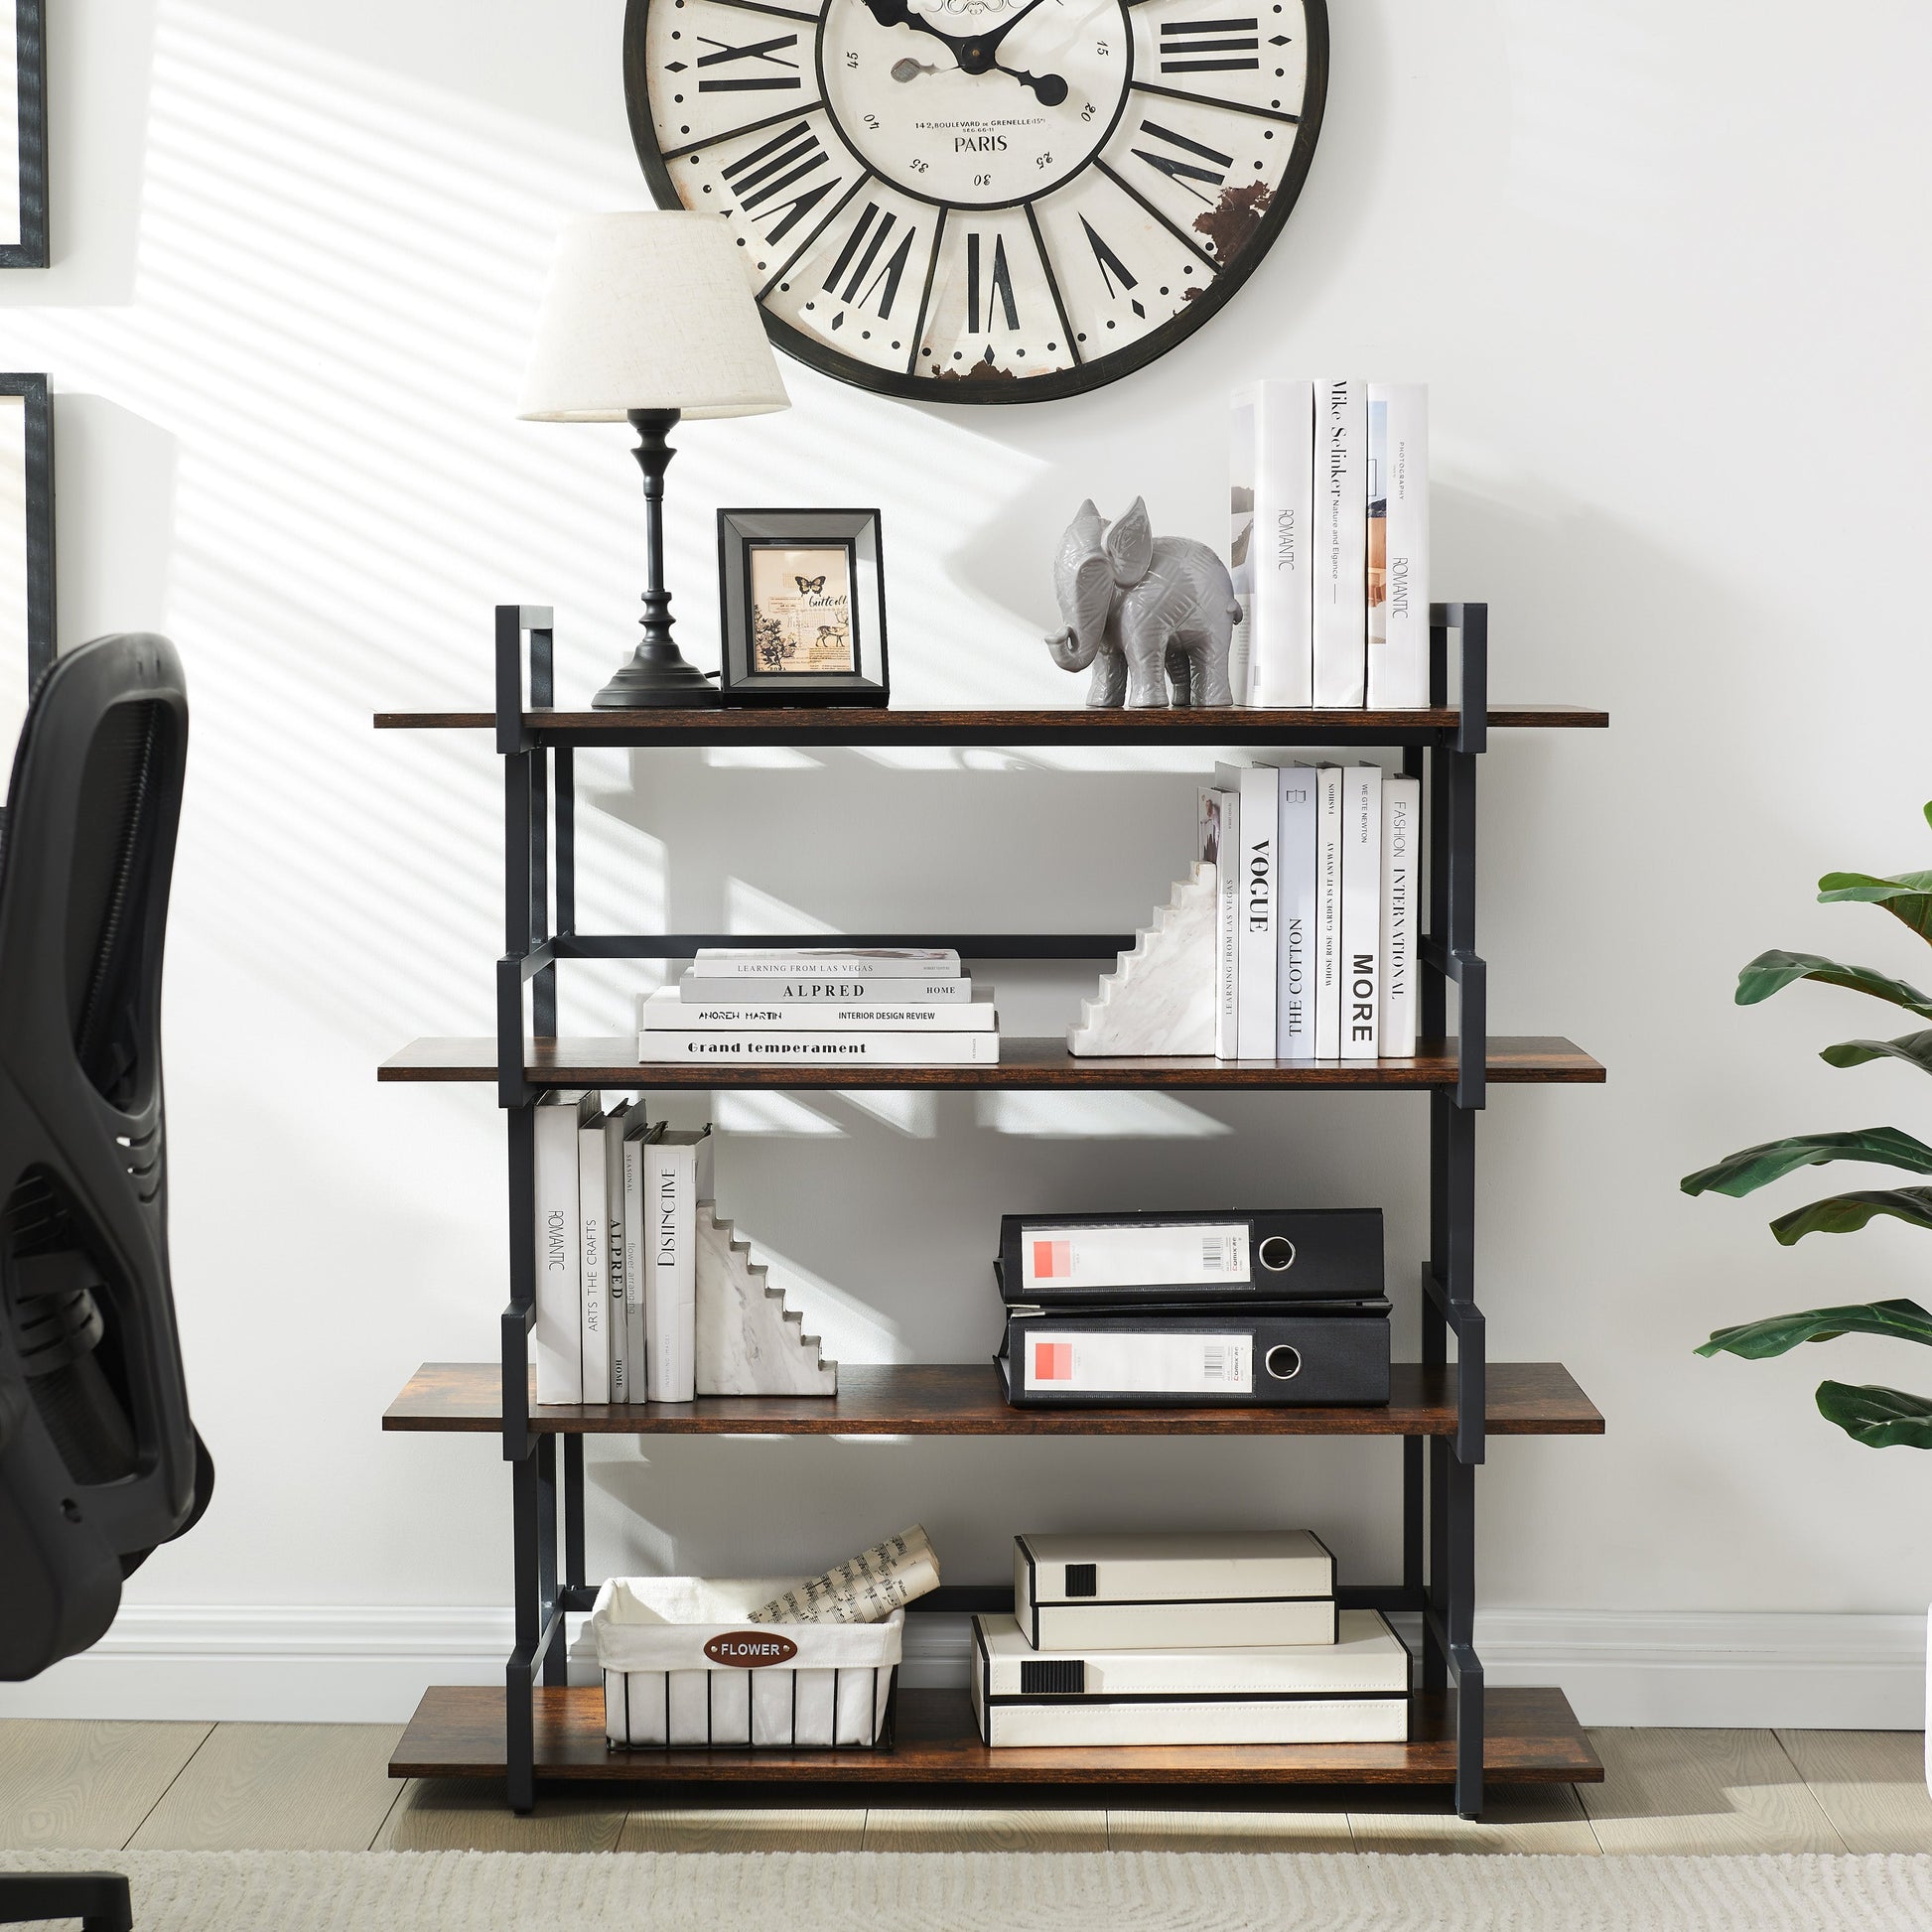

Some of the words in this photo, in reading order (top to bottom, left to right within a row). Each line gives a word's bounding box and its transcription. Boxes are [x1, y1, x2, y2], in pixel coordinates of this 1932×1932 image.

[847, 52, 859, 69] 45
[1097, 41, 1108, 56] 15
[864, 114, 880, 130] 40
[1081, 102, 1096, 122] 20
[955, 135, 1007, 152] PARIS
[909, 159, 928, 173] 35
[1036, 152, 1053, 170] 25
[974, 175, 991, 186] 30
[1078, 210, 1138, 300] V
[1331, 381, 1347, 419] Mike
[1331, 427, 1347, 496] Selinker
[1279, 510, 1294, 570] ROMANTIC
[1393, 558, 1408, 619] ROMANTIC
[1362, 784, 1368, 795] WE
[1394, 802, 1406, 858] FASHION
[1250, 840, 1269, 932] VOGUE
[1392, 870, 1405, 999] INTERNATIONAL
[841, 964, 873, 973] VEGAS
[1290, 919, 1302, 994] COTTON
[783, 985, 865, 997] ALPRED
[1353, 955, 1373, 1041] MORE
[746, 1012, 781, 1021] MARTIN
[1290, 1001, 1302, 1036] THE
[688, 1041, 741, 1053] Grand
[749, 1042, 867, 1055] temperament
[657, 1170, 676, 1266] DISTINCTIVE
[548, 1210, 564, 1270] ROMANTIC
[587, 1220, 597, 1265] CRAFTS
[610, 1218, 623, 1300] ALPRED
[626, 1242, 635, 1271] flower
[588, 1272, 598, 1296] THE
[626, 1272, 635, 1314] arranging
[588, 1303, 598, 1331] ARTS
[615, 1359, 623, 1388] HOME
[722, 1644, 779, 1655] FLOWER
